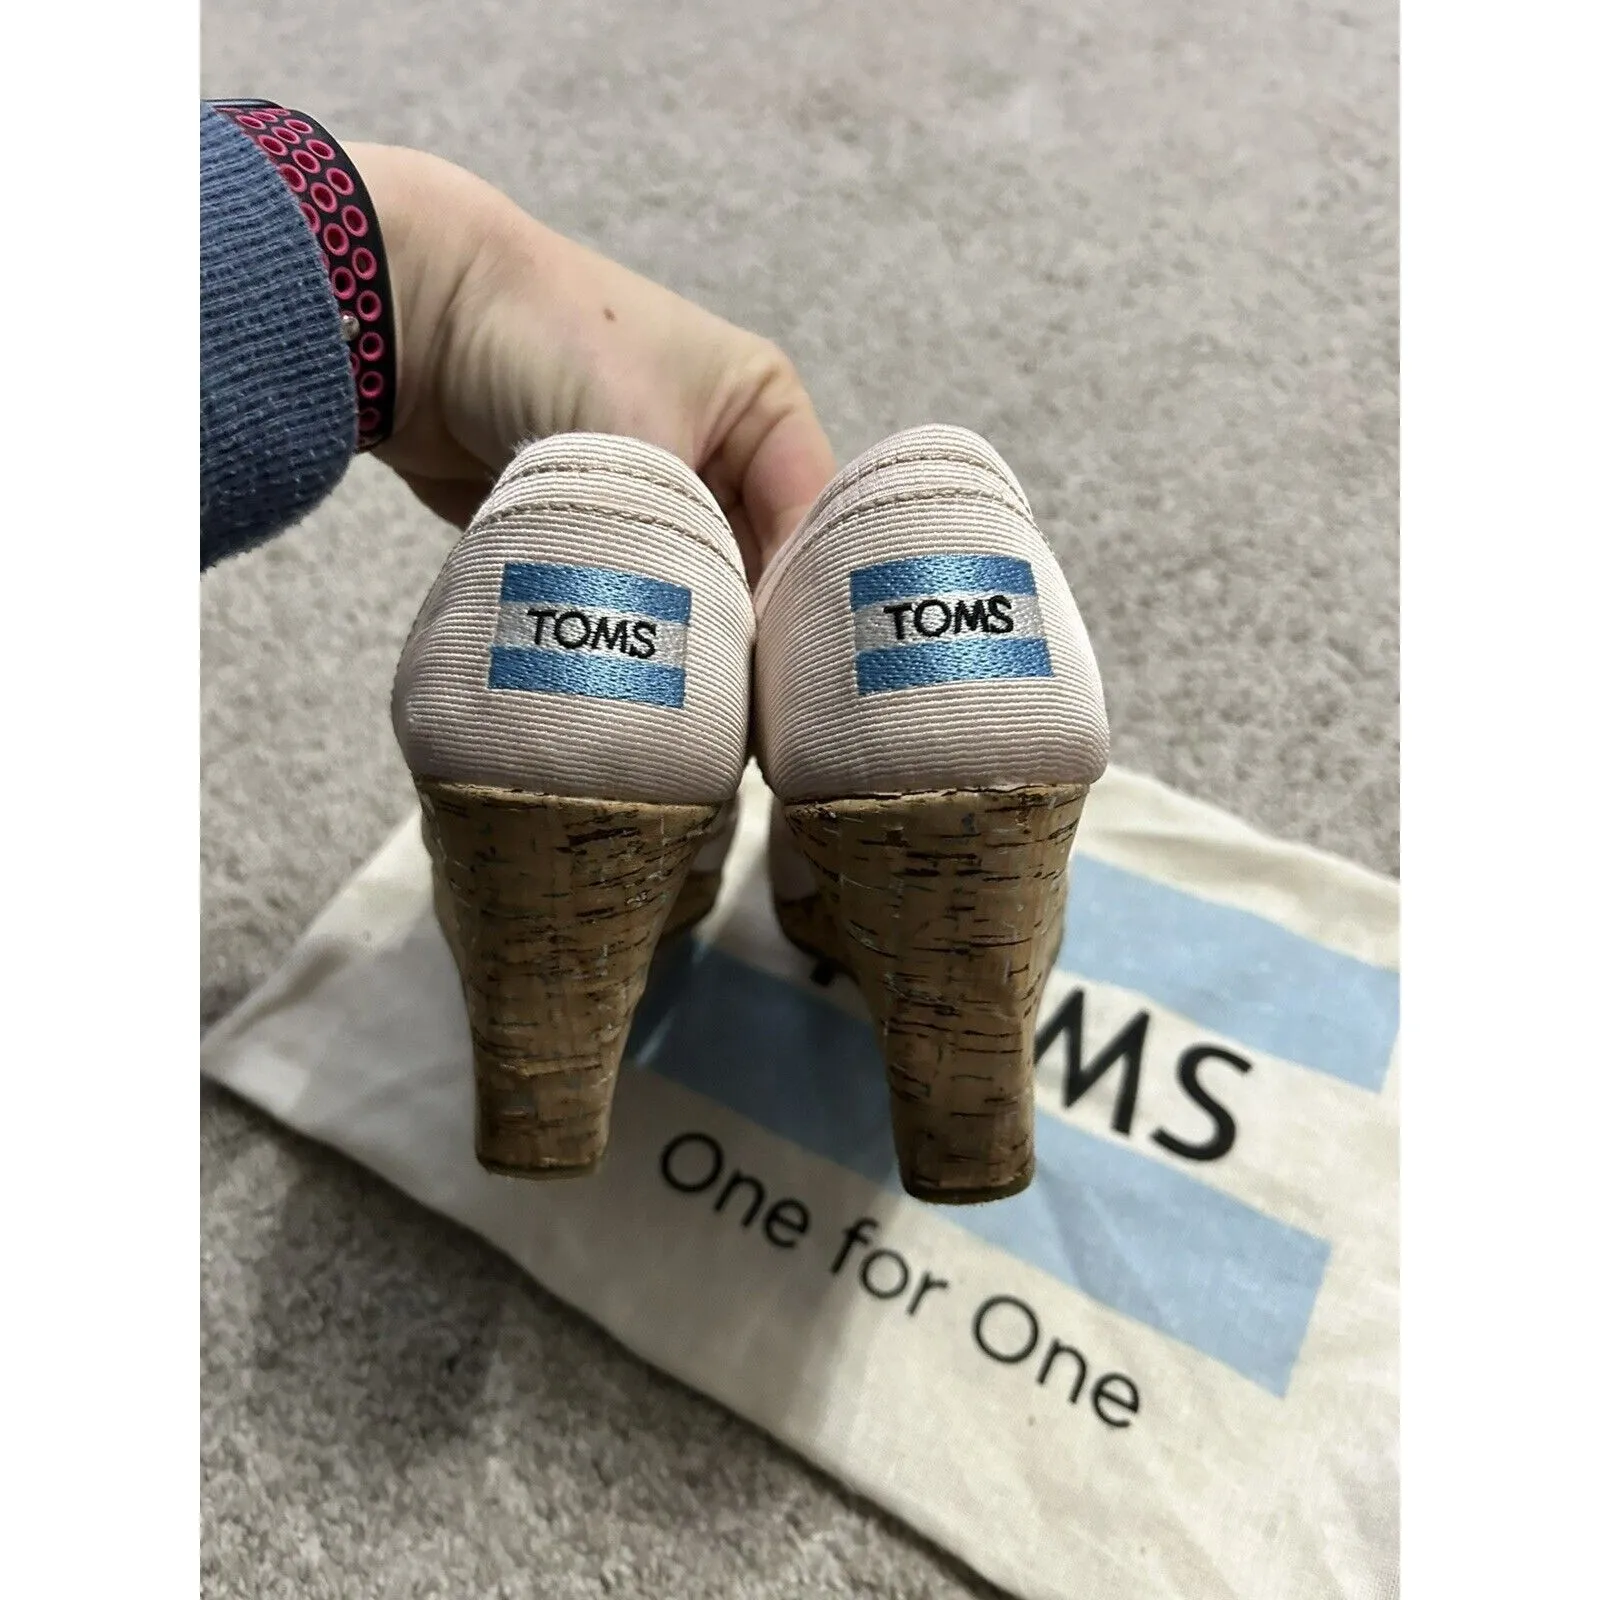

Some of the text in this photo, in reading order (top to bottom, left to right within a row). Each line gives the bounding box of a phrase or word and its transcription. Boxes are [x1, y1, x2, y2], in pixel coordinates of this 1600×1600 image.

[526, 608, 656, 660] TOMS
[884, 594, 1015, 640] TOMS
[660, 1131, 1141, 1429] One for One
